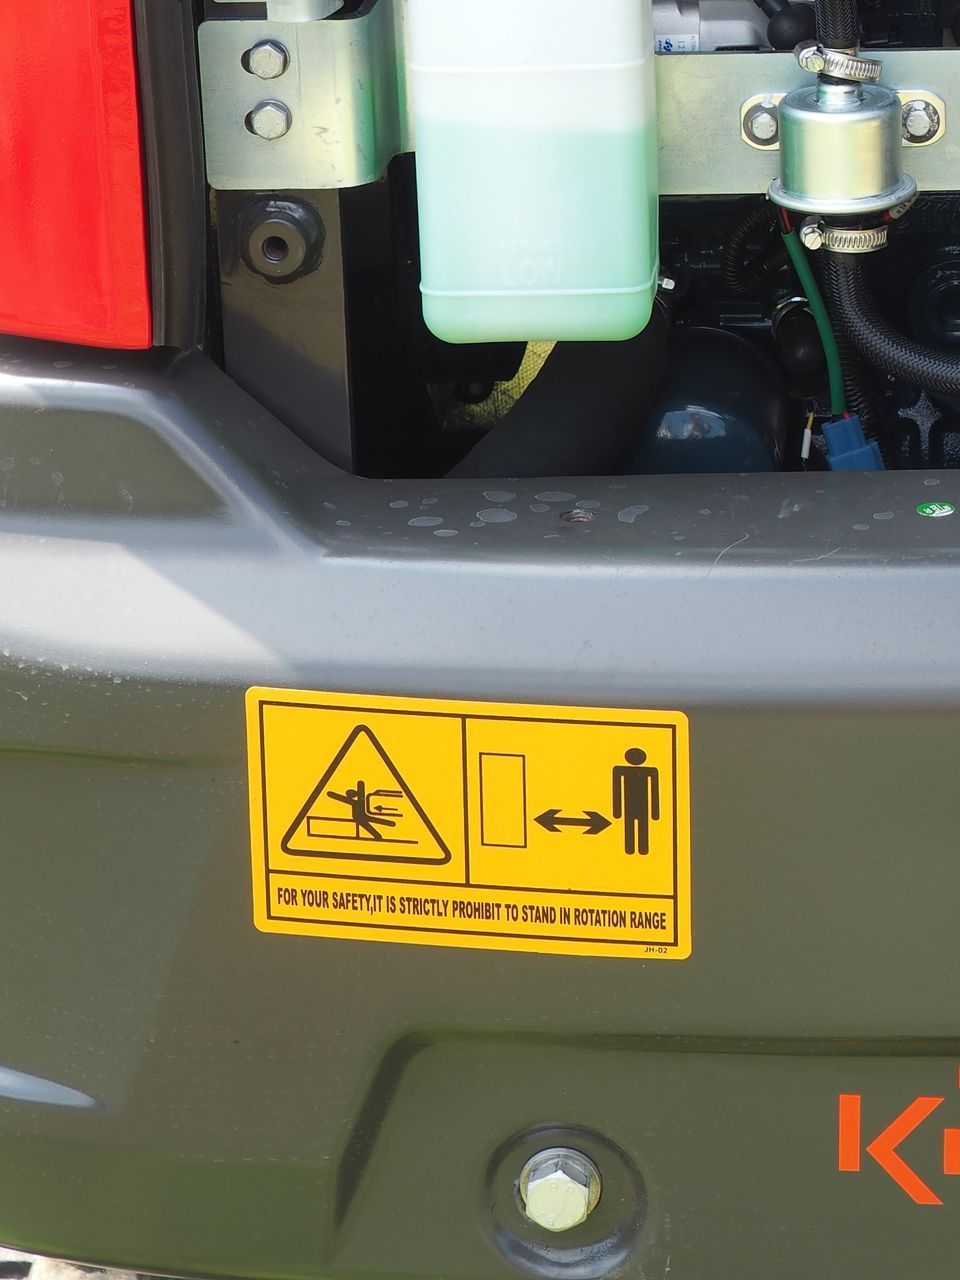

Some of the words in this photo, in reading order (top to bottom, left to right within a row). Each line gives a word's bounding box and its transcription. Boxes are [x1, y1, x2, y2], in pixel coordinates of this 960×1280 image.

[277, 887, 298, 906] FOR
[300, 889, 329, 909] YOUR
[332, 891, 383, 916] SAFETY,IT
[386, 896, 396, 912] IS
[399, 897, 449, 918] STRICTLY
[452, 900, 501, 920] PROHIBIT
[505, 903, 519, 921] TO
[521, 905, 557, 924] STAND
[559, 907, 571, 925] IN
[574, 909, 627, 928] ROTATION
[630, 912, 667, 930] RANGE
[644, 946, 668, 954] JH-02
